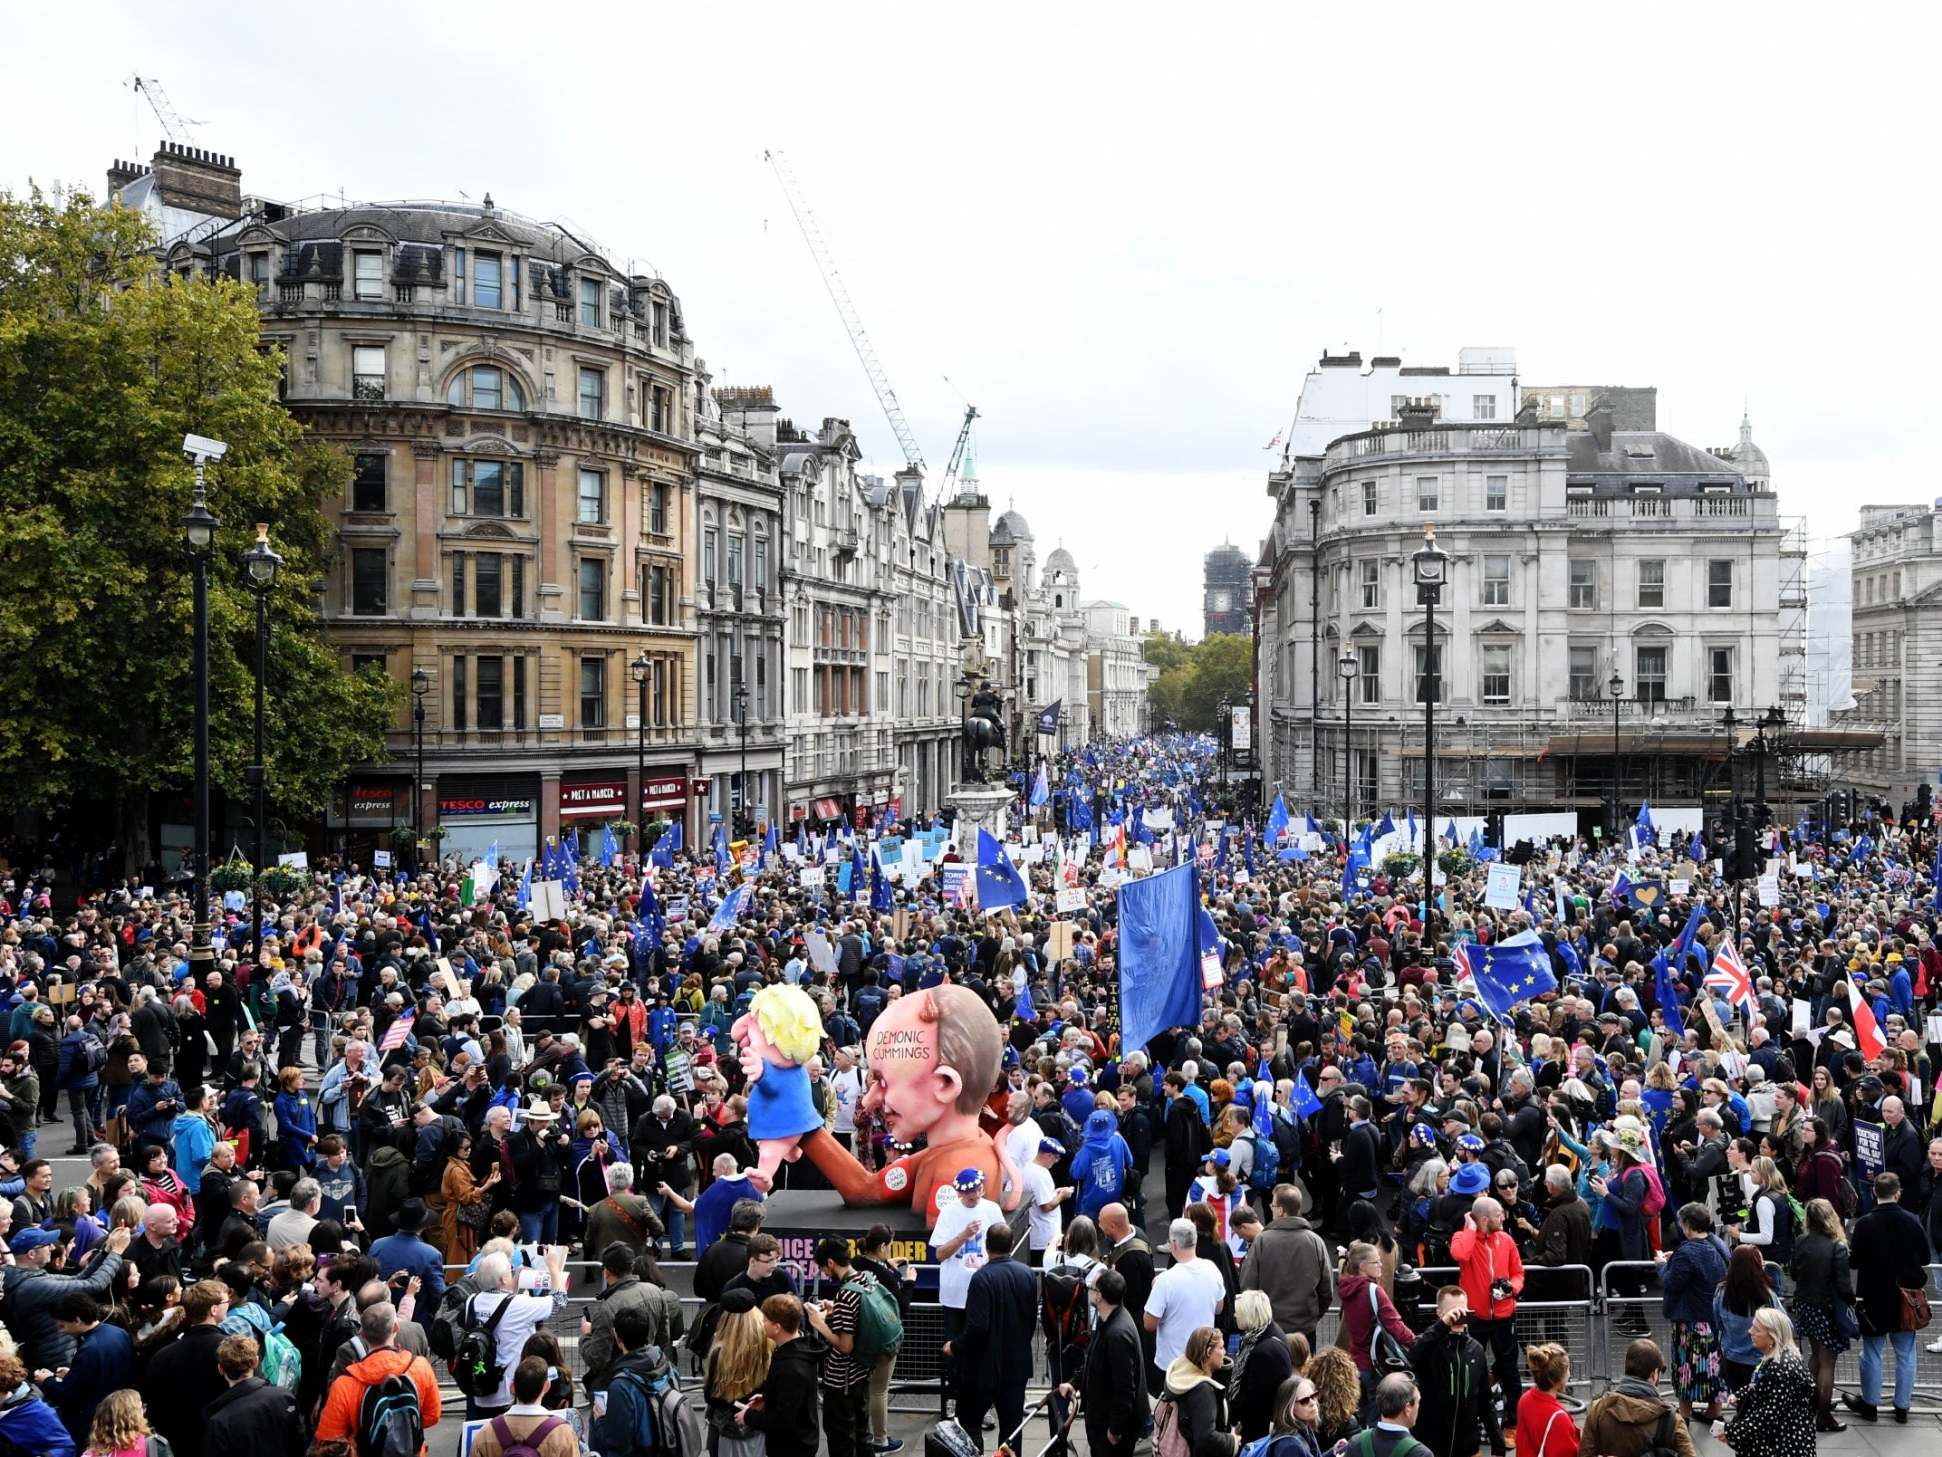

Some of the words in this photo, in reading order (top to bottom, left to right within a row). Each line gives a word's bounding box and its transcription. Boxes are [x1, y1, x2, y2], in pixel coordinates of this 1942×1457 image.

[571, 790, 585, 801] PRET
[586, 789, 591, 800] A
[354, 801, 391, 811] express
[440, 800, 485, 810] TESCO
[488, 799, 530, 809] express
[877, 1030, 925, 1044] DEMONIC
[873, 1047, 930, 1060] CUMMINGS
